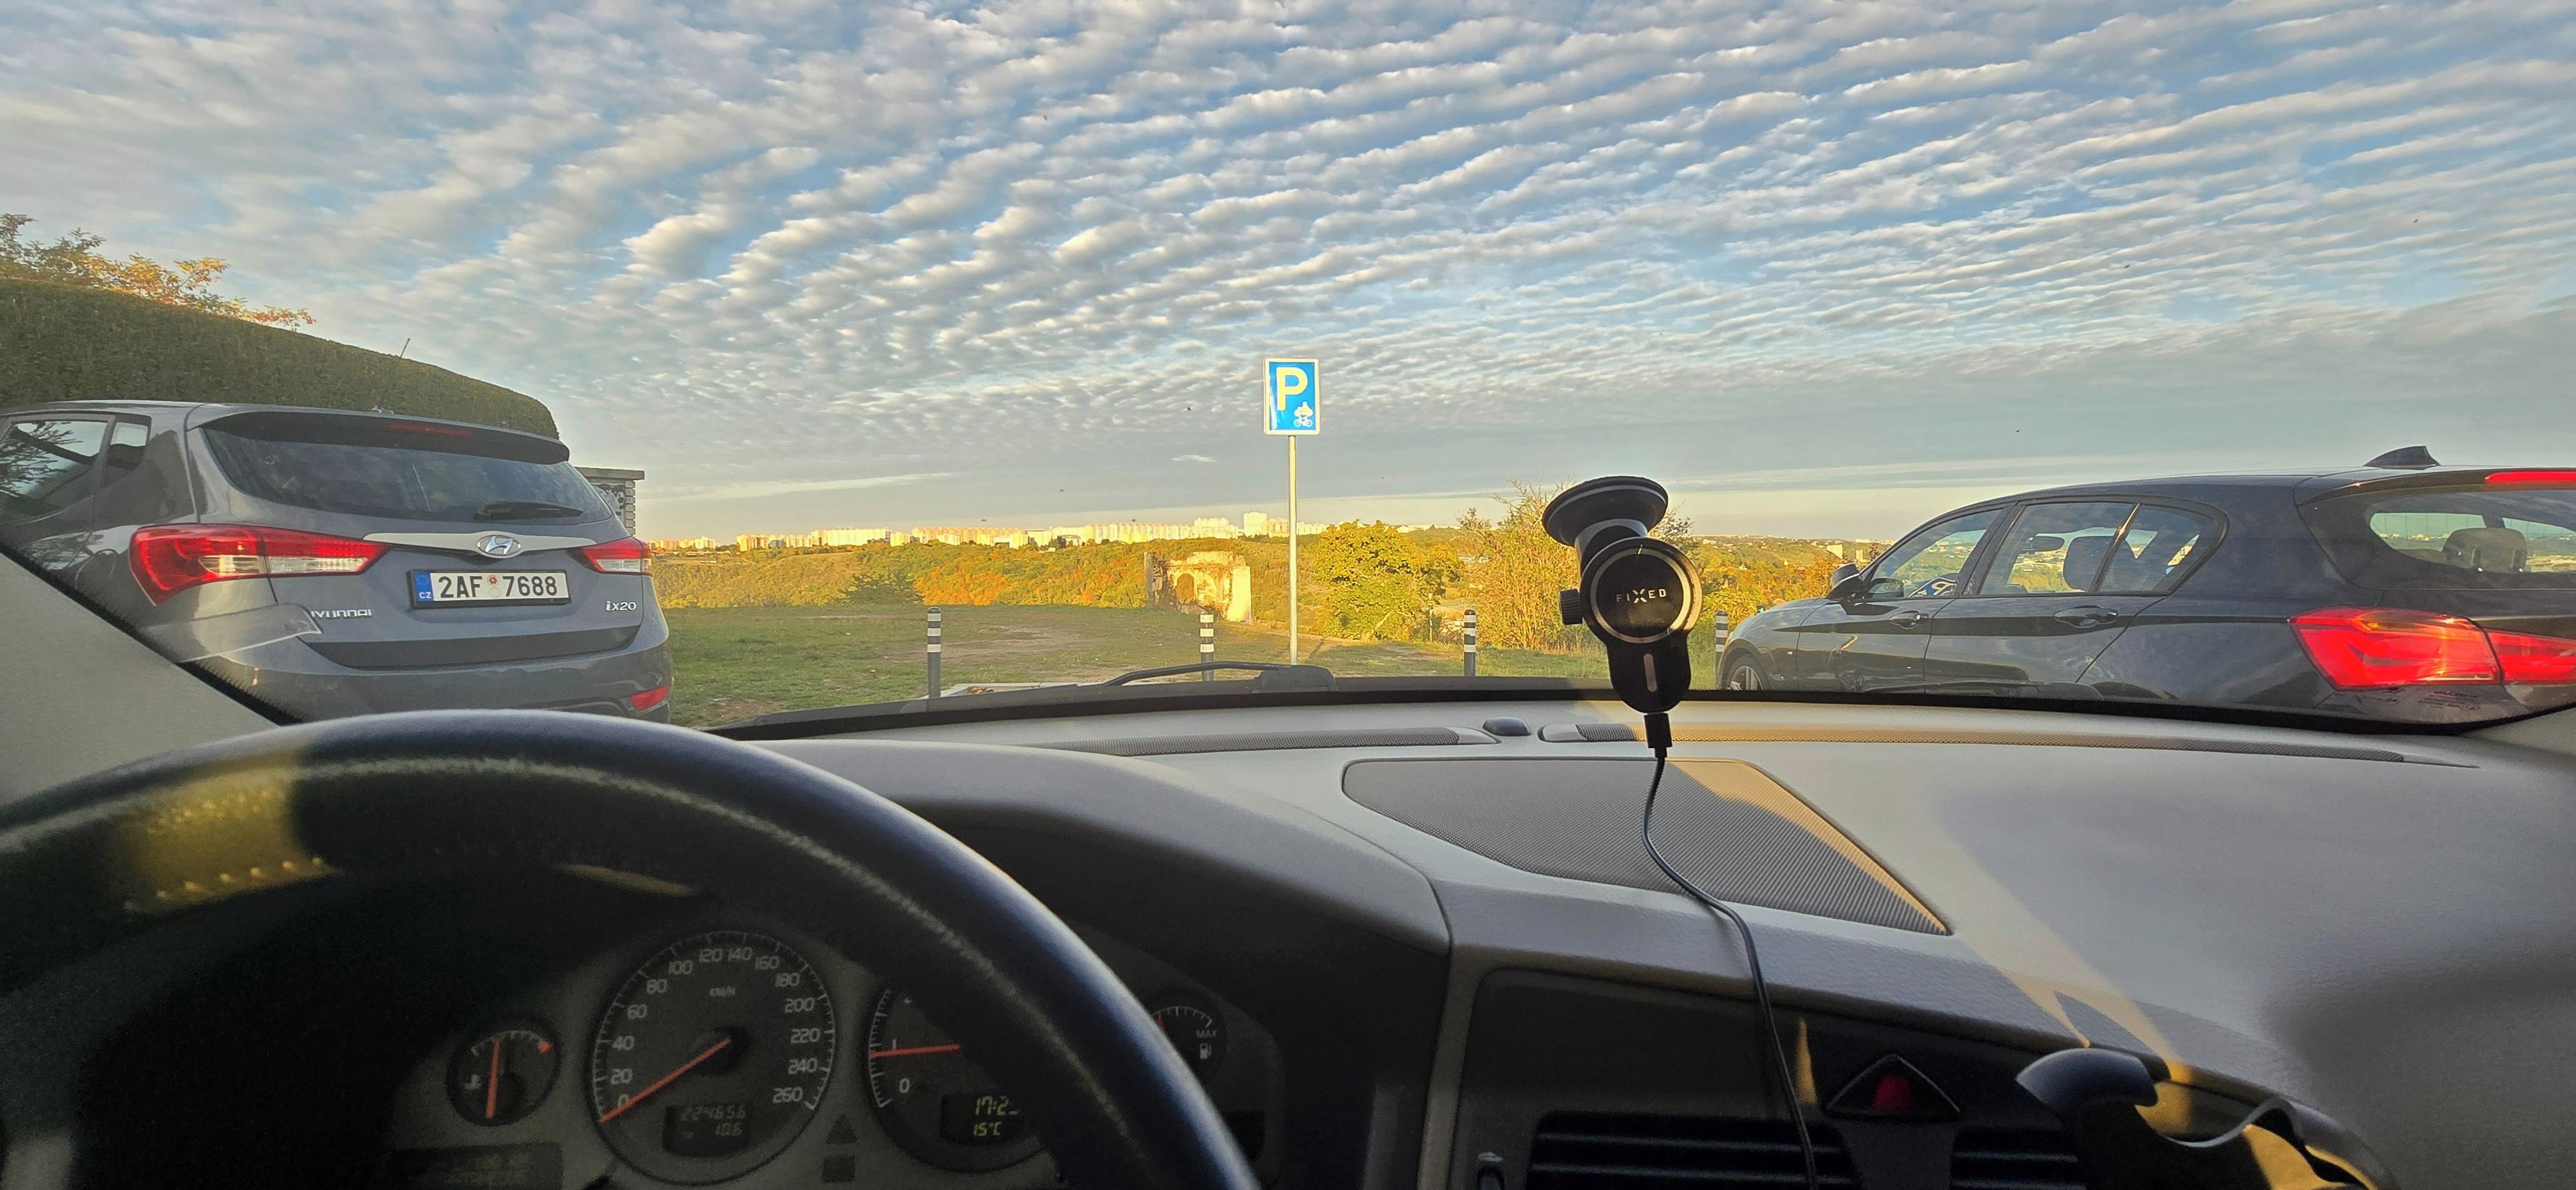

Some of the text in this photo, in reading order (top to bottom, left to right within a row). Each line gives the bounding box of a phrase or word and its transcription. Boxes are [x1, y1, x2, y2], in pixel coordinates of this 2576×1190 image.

[1276, 367, 1308, 411] P
[439, 576, 558, 598] 2AF 7688
[1616, 589, 1667, 603] FIXED
[605, 601, 636, 611] ix20
[699, 948, 723, 963] 120
[728, 947, 752, 961] 140
[668, 959, 692, 975] 100
[755, 956, 780, 970] 160
[646, 979, 668, 994] 80
[775, 972, 800, 987] 180
[627, 1004, 647, 1020] 60
[784, 997, 814, 1013] 200
[790, 1028, 820, 1044] 220
[1196, 1030, 1217, 1038] MAX
[612, 1035, 634, 1050] 40
[788, 1058, 817, 1074] 240
[610, 1068, 632, 1084] 20
[898, 1079, 911, 1093] 0
[773, 1087, 803, 1102] 260
[974, 1095, 1019, 1117] 17:2
